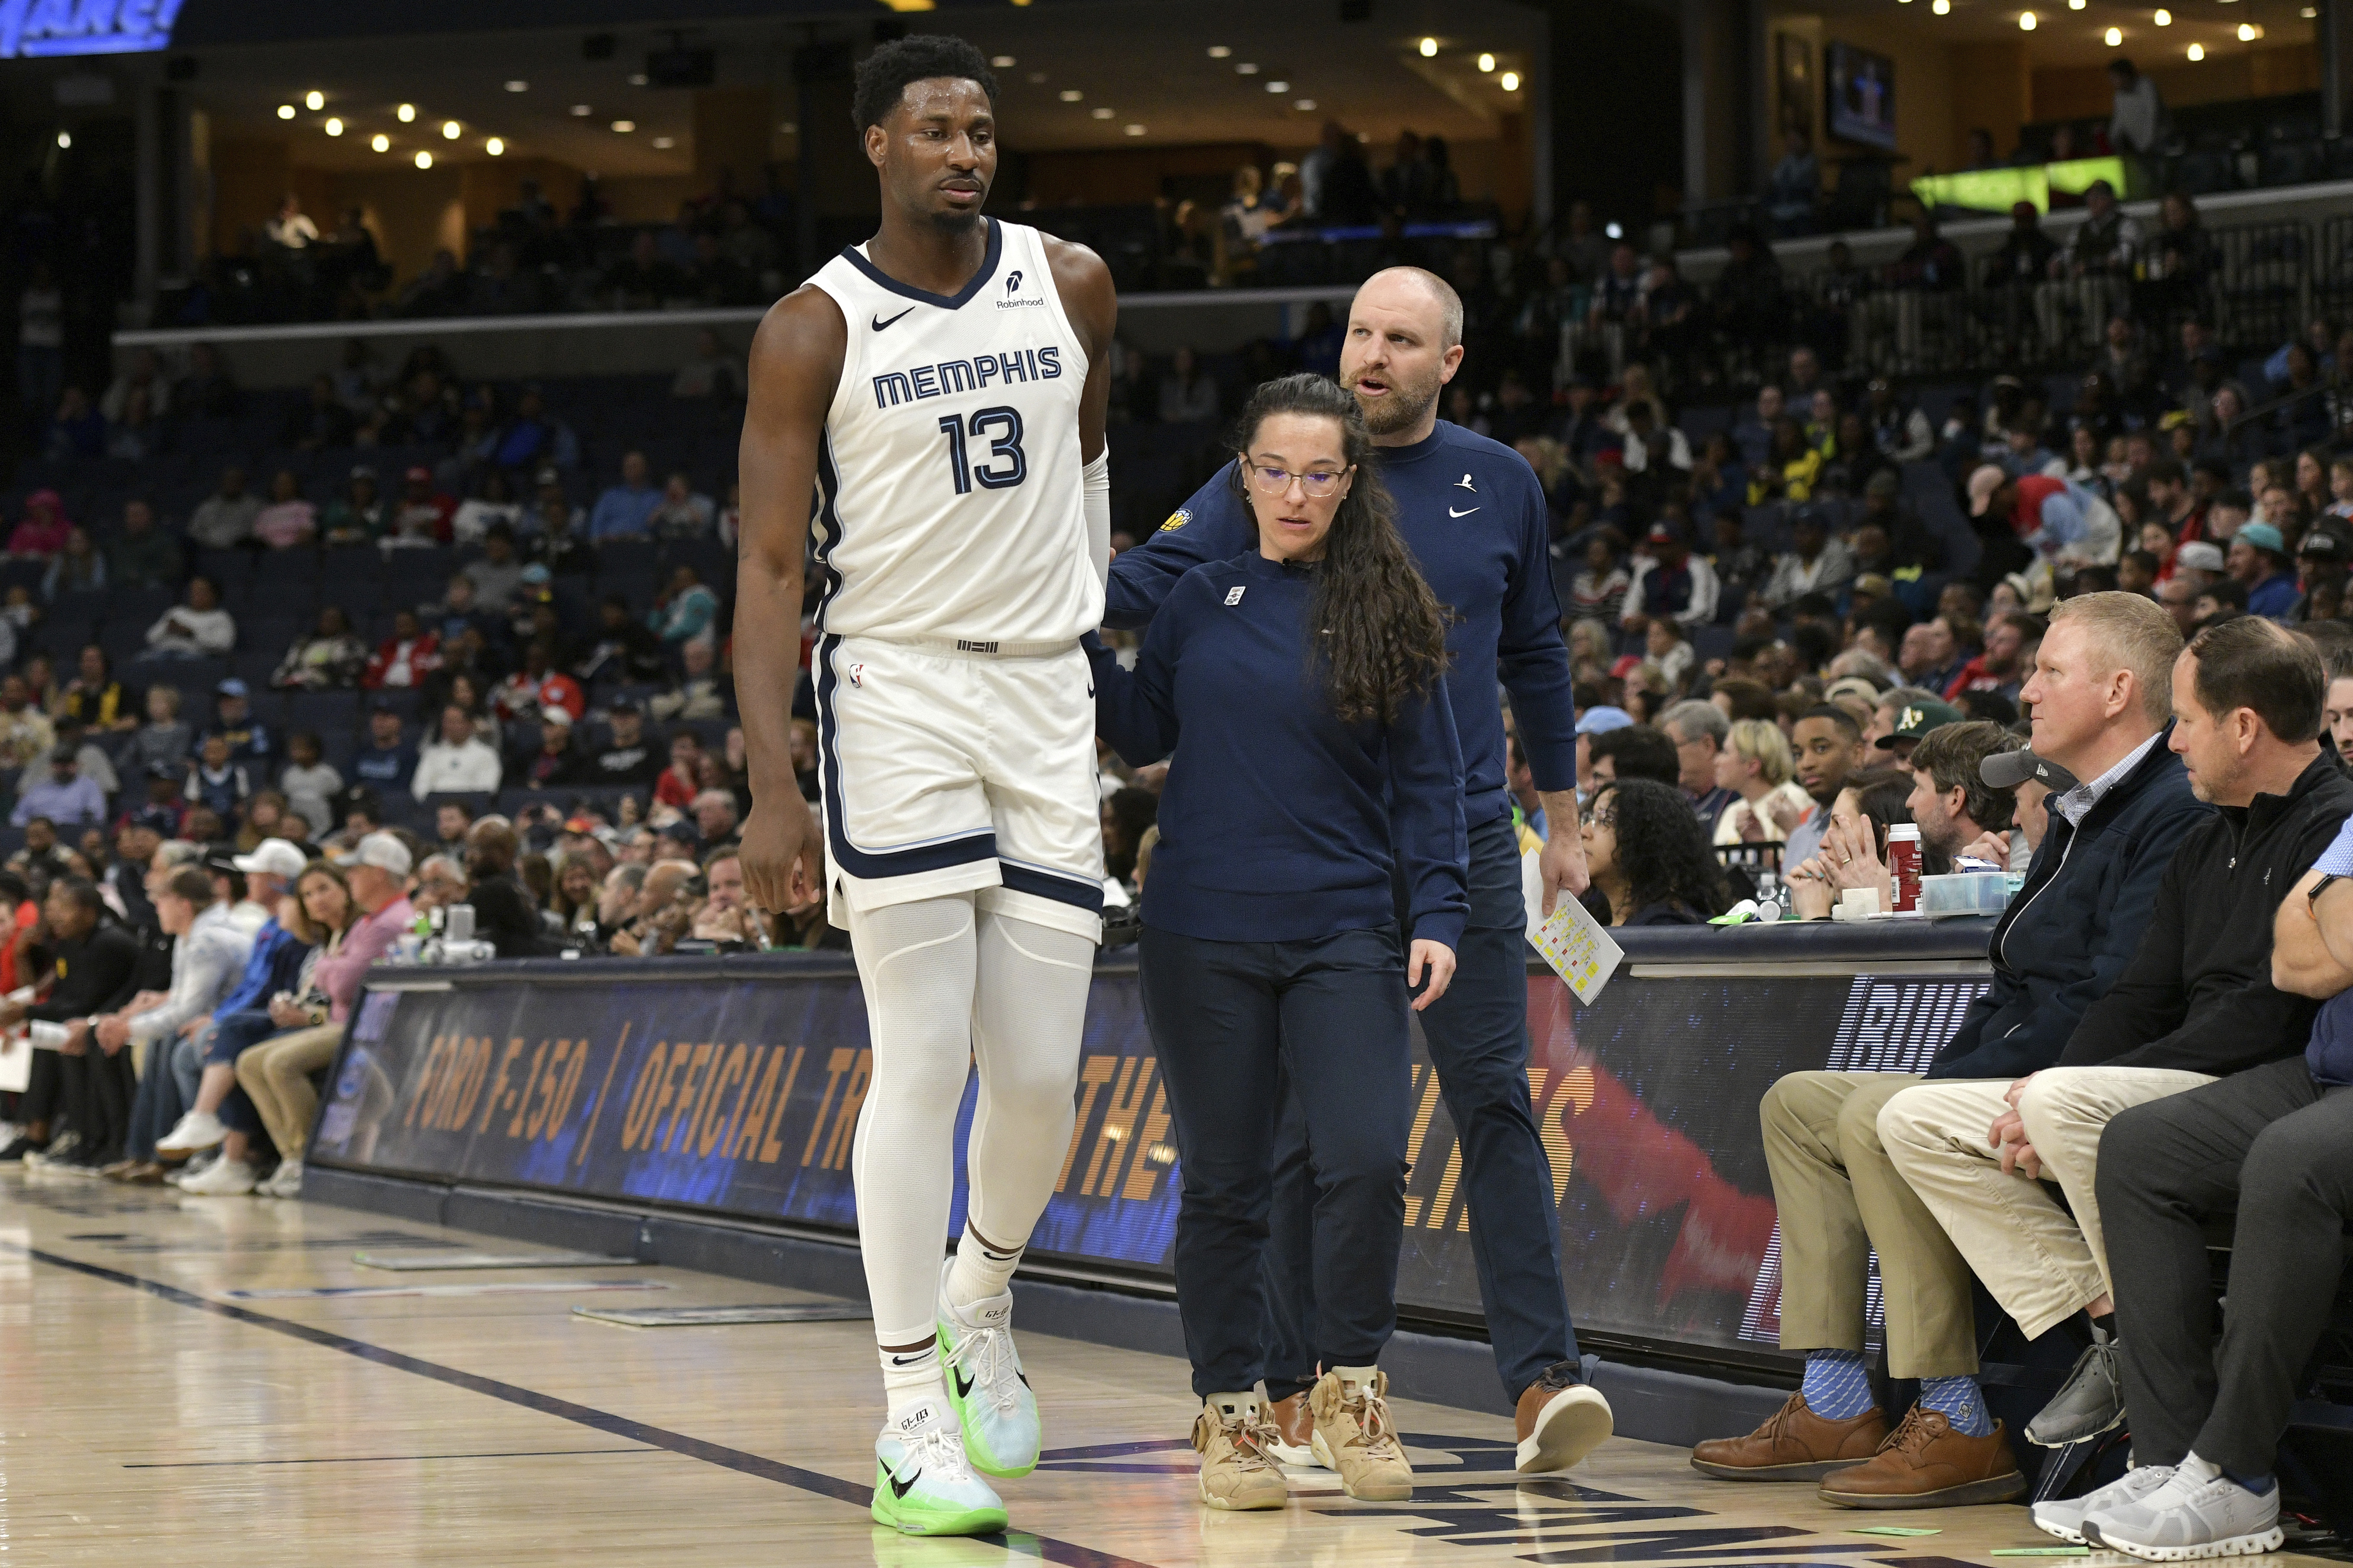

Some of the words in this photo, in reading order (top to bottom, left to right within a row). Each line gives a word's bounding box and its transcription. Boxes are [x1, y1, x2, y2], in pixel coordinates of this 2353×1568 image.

[996, 298, 1044, 310] Robinhood
[872, 346, 1062, 409] MEMPHIS
[938, 405, 1027, 495] 13
[478, 1037, 589, 1143] F-150
[621, 1040, 806, 1164] OFFICIAL
[1053, 1055, 1171, 1201] THE
[909, 1419, 925, 1430] HUSTLE
